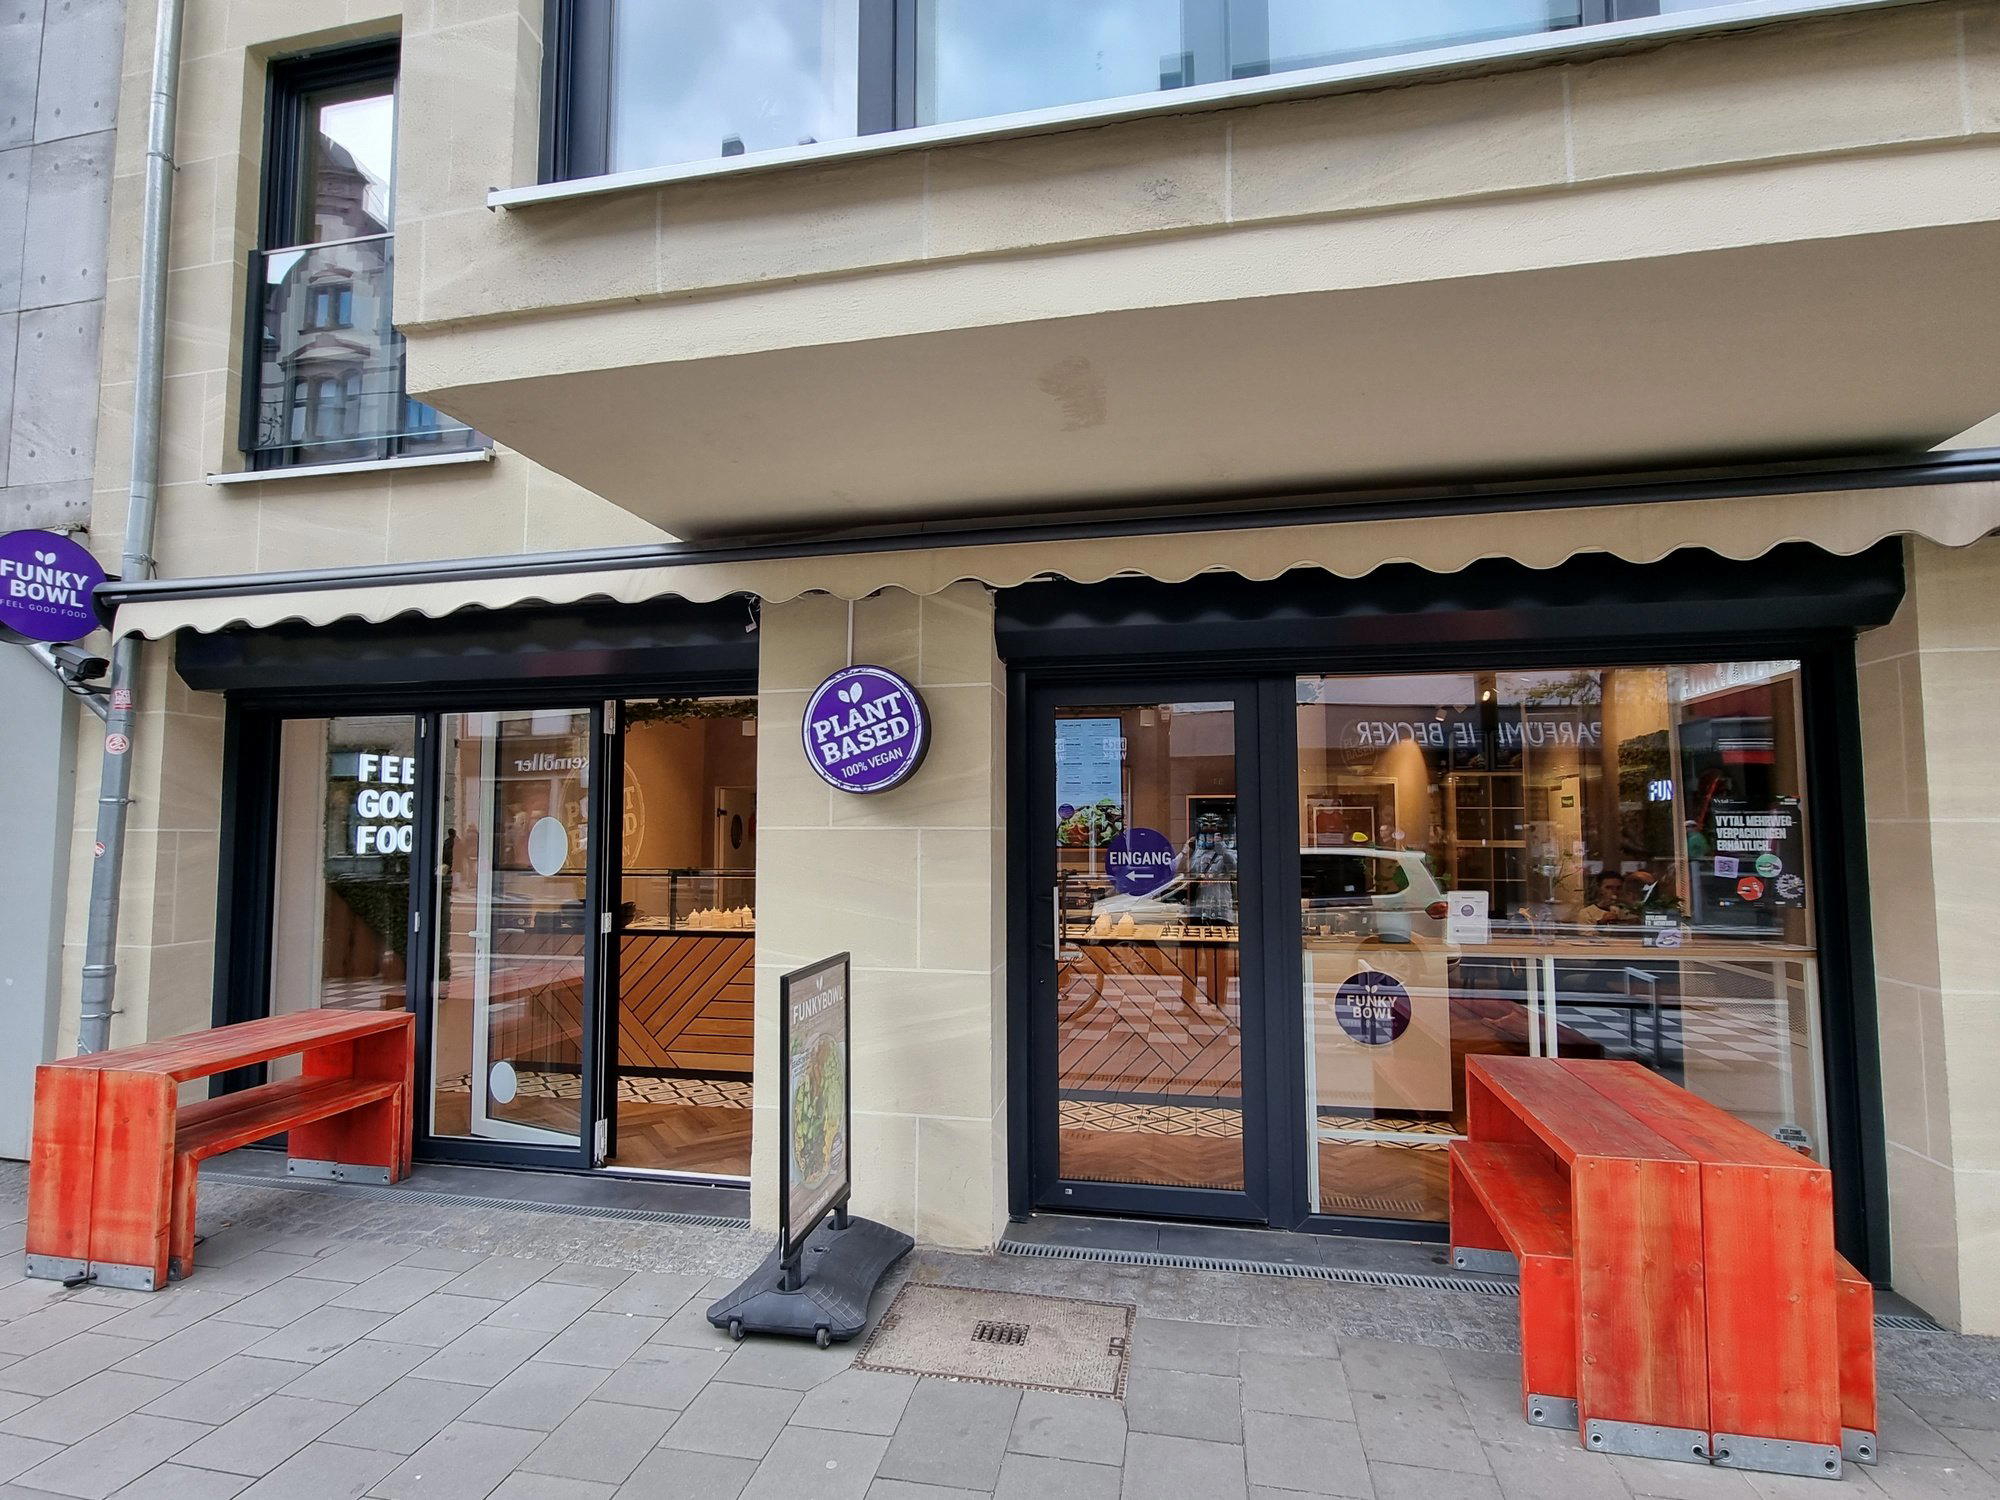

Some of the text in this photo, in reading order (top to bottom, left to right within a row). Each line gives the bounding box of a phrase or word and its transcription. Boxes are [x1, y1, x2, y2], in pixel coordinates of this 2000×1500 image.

[0, 559, 89, 590] FUNKY
[10, 580, 84, 608] BOWL
[29, 604, 57, 614] GOOD
[61, 609, 87, 619] FOOD
[812, 691, 902, 743] PLANT
[820, 716, 910, 765] BASED
[841, 747, 903, 778] 100% VEGAN
[1715, 815, 1745, 827] VYTAL
[1716, 827, 1787, 839] VERPACKUNGEN
[1109, 851, 1172, 866] EINGANG
[1346, 995, 1397, 1008] FUNKY
[1352, 1006, 1395, 1019] BOWL
